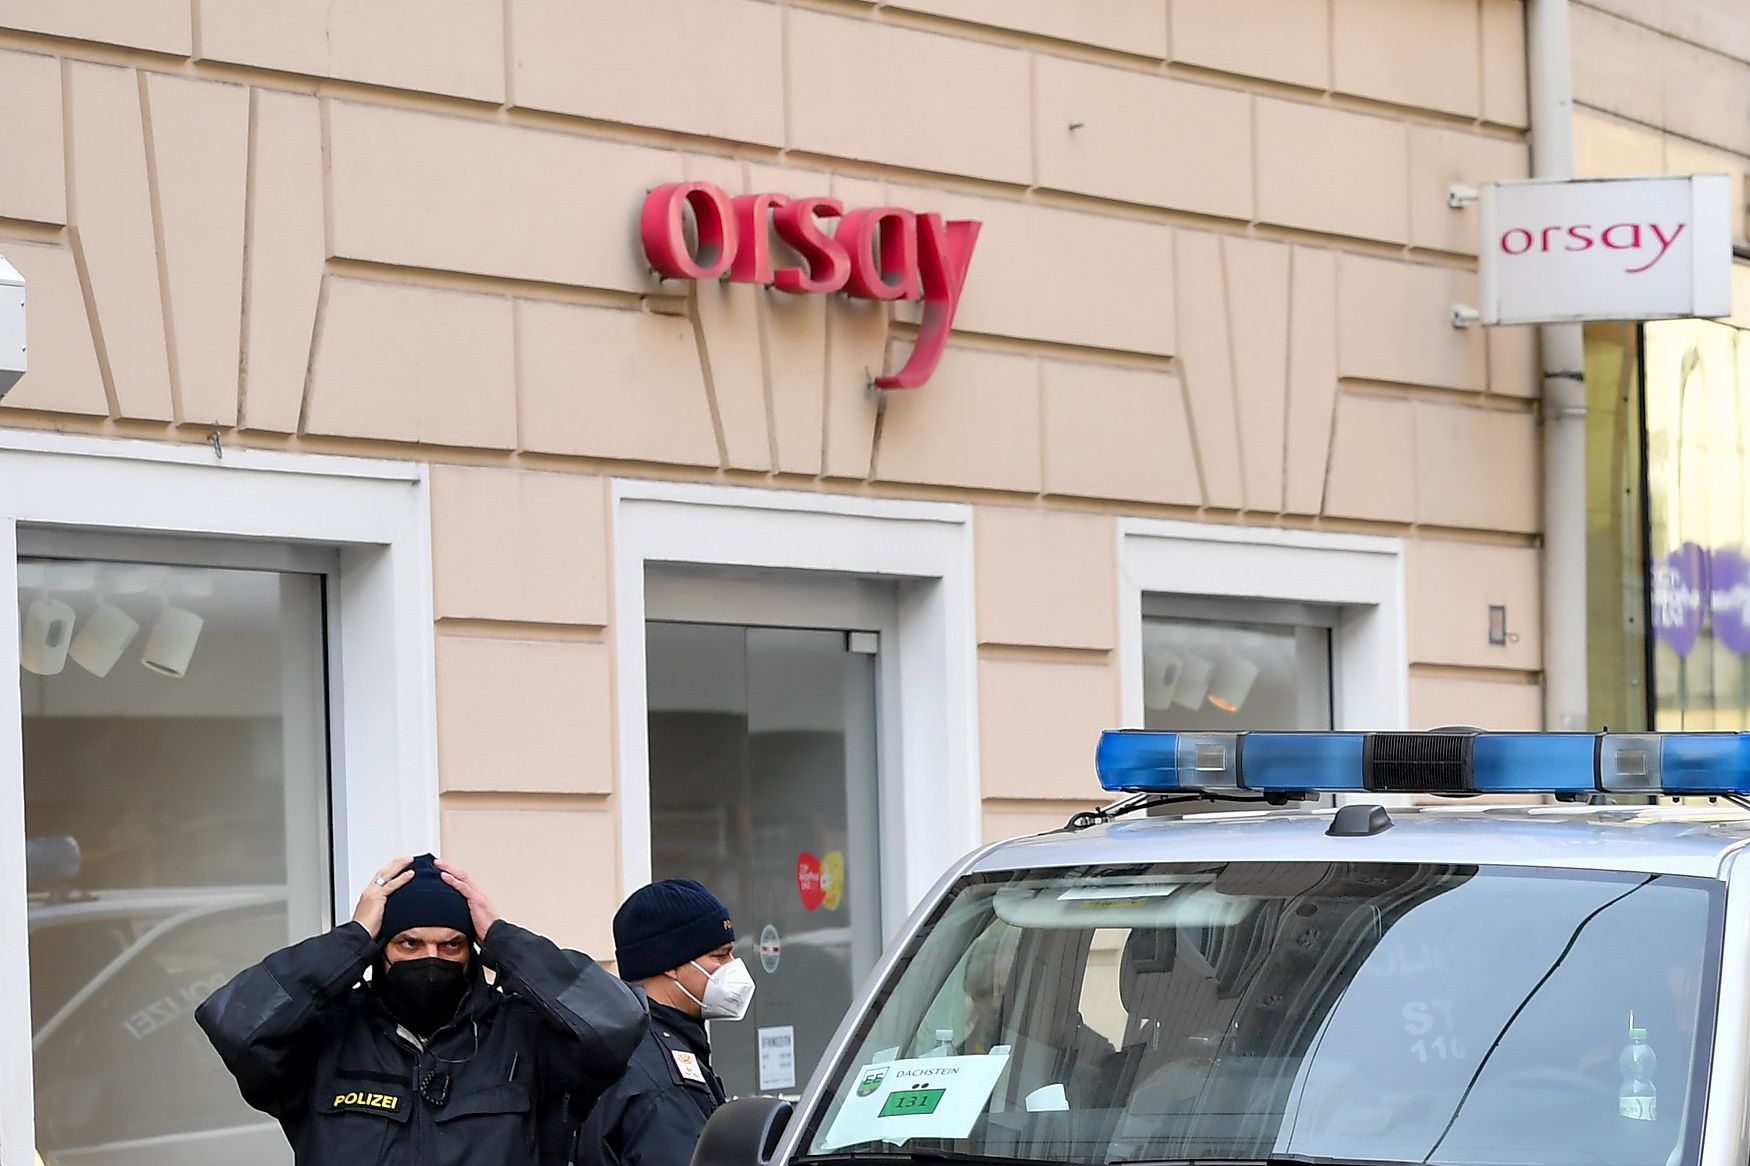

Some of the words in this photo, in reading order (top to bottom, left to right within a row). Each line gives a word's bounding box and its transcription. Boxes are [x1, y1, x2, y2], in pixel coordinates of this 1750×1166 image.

[1501, 222, 1686, 273] orsay
[641, 181, 982, 390] orsay
[896, 1066, 960, 1079] DACHSTEIN
[333, 1091, 399, 1110] POLIZEI
[895, 1094, 929, 1109] 131
